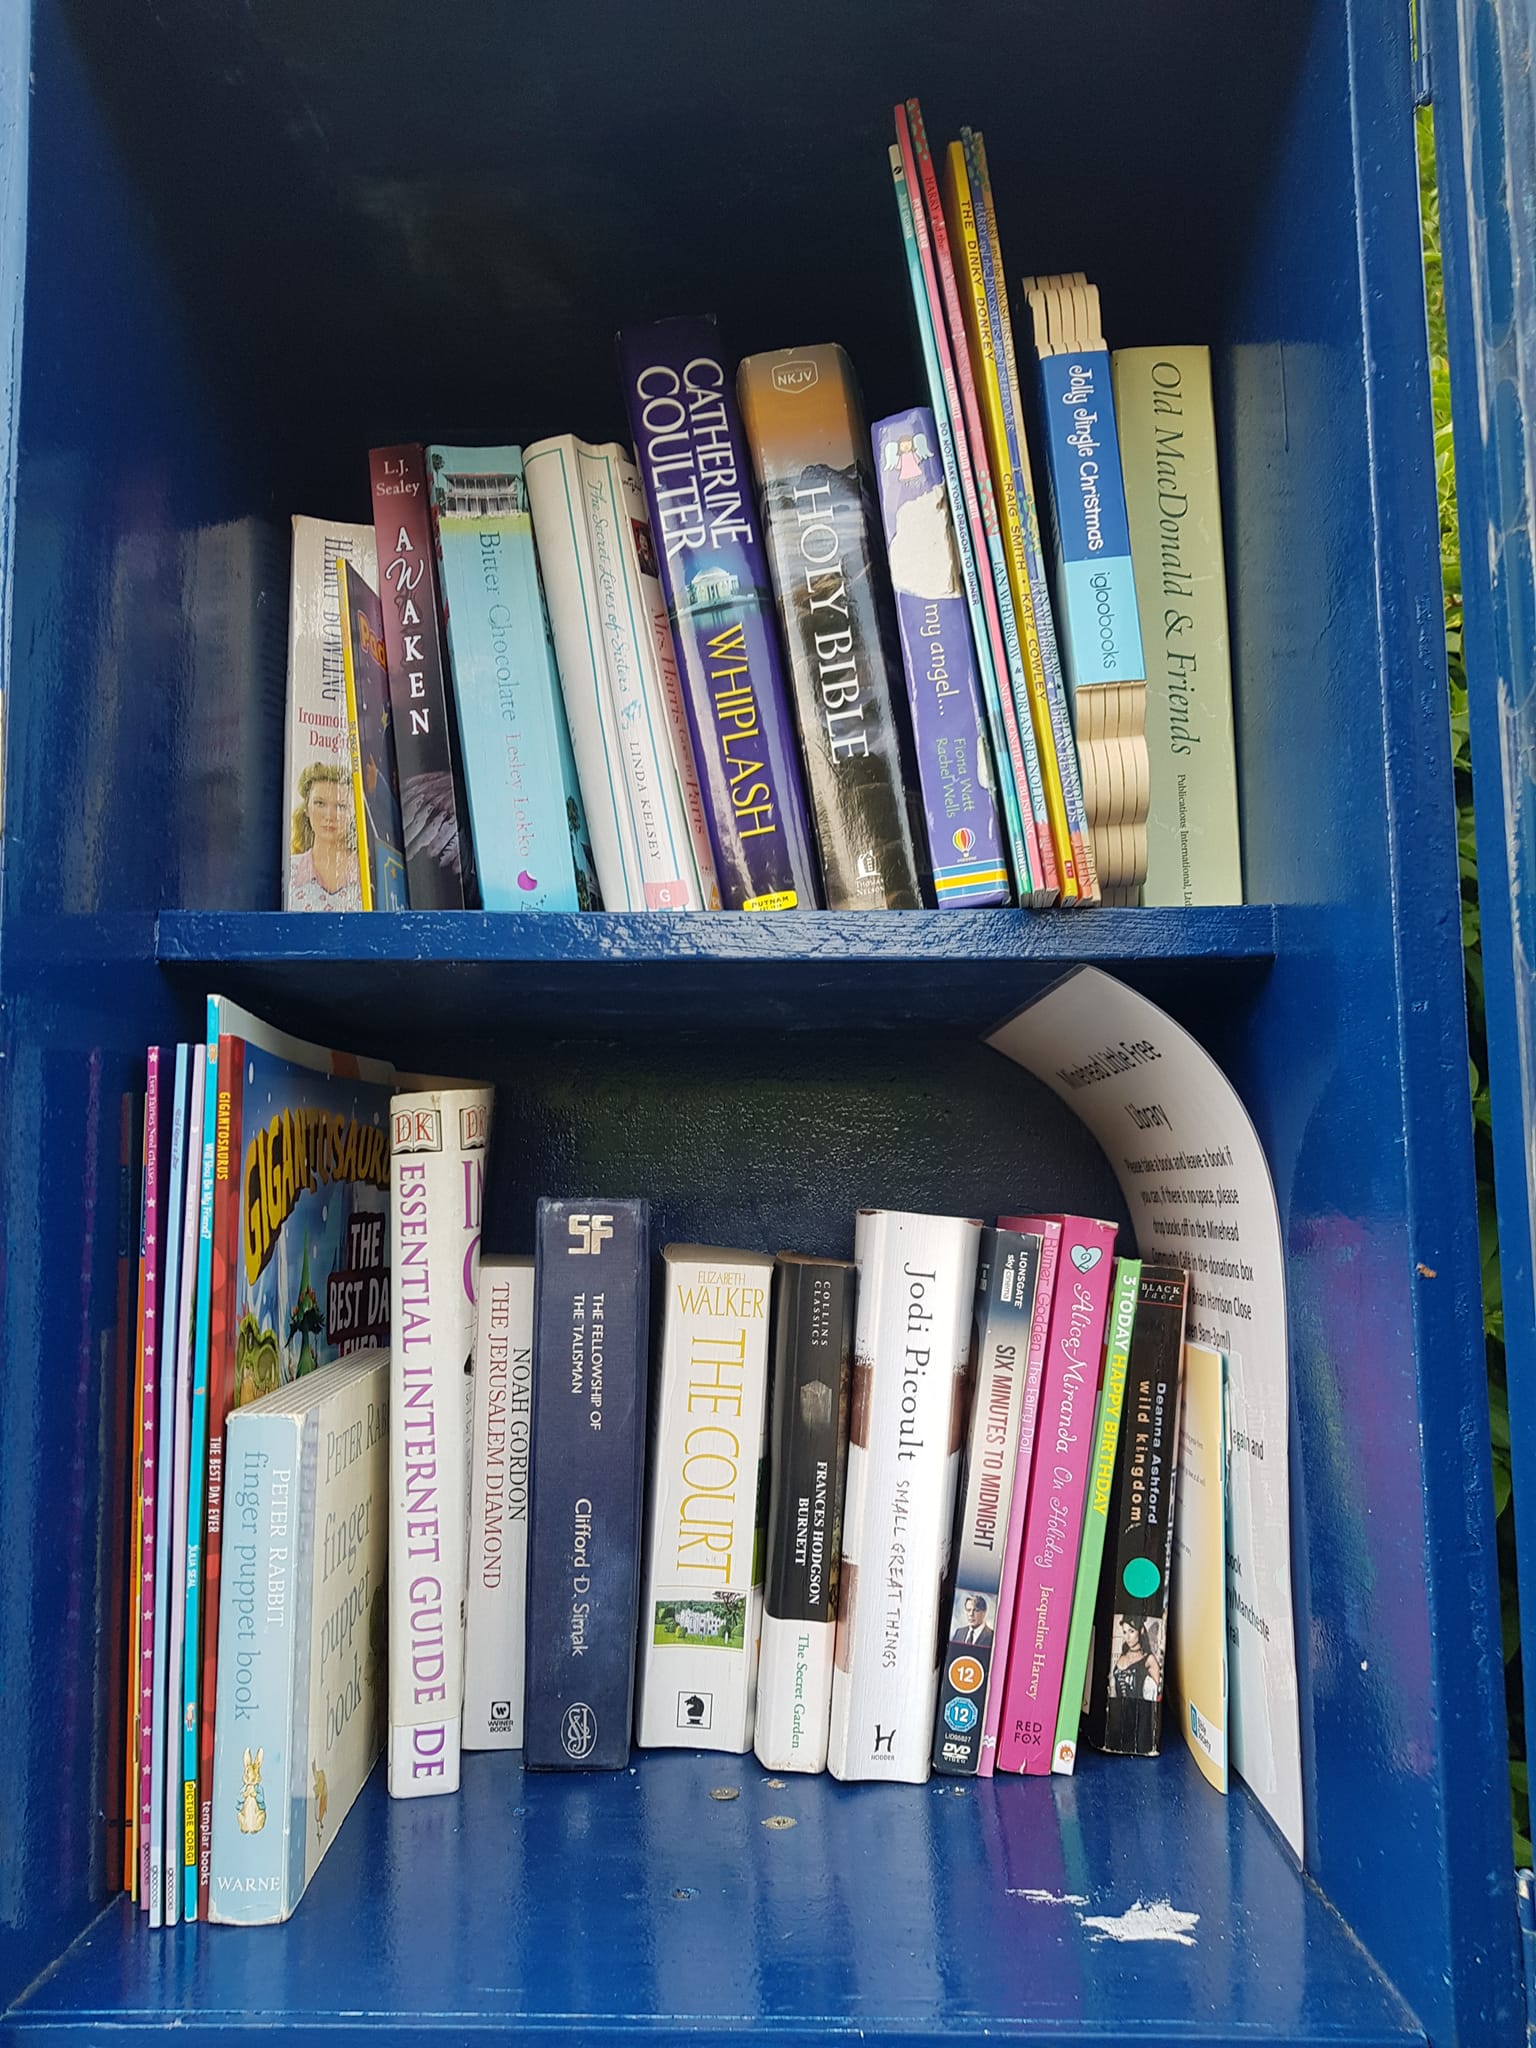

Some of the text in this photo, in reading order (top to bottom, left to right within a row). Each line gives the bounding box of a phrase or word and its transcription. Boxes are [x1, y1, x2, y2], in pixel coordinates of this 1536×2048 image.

[778, 370, 813, 386] NKJV
[376, 481, 420, 497] Sealey
[384, 460, 409, 476] L.J.
[637, 366, 707, 561] COULTER
[682, 357, 753, 549] CATHERINE
[961, 200, 1046, 700] THE DINKY DONKEY CRAIG SMITH KATZ COWLEY
[1063, 364, 1105, 551] Jolly Jingle Christmas
[939, 422, 980, 606] DO NOT TAKE YOUR DRAGON TO DINNER
[1151, 361, 1200, 756] Old MacDonald & Friends
[386, 526, 431, 736] AWAKEN
[479, 530, 521, 722] Bitter Chocolate
[588, 480, 631, 693] The Secret Lives of Sisters
[793, 481, 870, 764] HOLY BIBLE
[920, 603, 941, 636] my
[1089, 571, 1117, 669] igloobooks
[707, 622, 776, 839] WHIPLASH
[953, 737, 976, 812] Fiona Watt
[504, 734, 537, 858] Lesley Lokko
[629, 741, 661, 861] LINDA KELSEY
[936, 737, 960, 819] Rachel Wells
[751, 895, 789, 909] PUTNAM
[1097, 1045, 1136, 1077] Little
[1119, 1039, 1162, 1065] Free
[395, 1112, 432, 1145] DK
[1125, 1103, 1173, 1132] Library
[351, 1221, 381, 1271] THE
[568, 1214, 614, 1255] SF
[698, 1271, 746, 1285] ELIZABETH
[1002, 1254, 1015, 1301] sky cinema
[1078, 1252, 1092, 1270] 2
[207, 1091, 232, 1534] GIGANTOSAURUS THE BEST DAY EVER
[329, 1280, 363, 1335] BEST
[677, 1284, 766, 1319] WALKER
[811, 1280, 822, 1346] CLASSICS
[821, 1281, 831, 1346] COLLINS
[1014, 1251, 1029, 1310] LIONSGATE
[1031, 1236, 1059, 1352] Rumer Godden
[1141, 1283, 1181, 1295] BLACK
[1206, 1290, 1233, 1316] Harrison
[1233, 1296, 1252, 1320] Close
[571, 1292, 585, 1394] THE TALISMAN
[589, 1292, 605, 1431] THE FELLOWSHIP OF
[897, 1262, 937, 1461] Jodi Picoult
[400, 1162, 446, 1705] ESSENTIAL INTERNET GUIDE
[482, 1281, 510, 1589] THE JERUSALEM DIAMOND
[508, 1347, 531, 1522] NOAH GORDON
[1019, 1359, 1043, 1454] The Fairy Doll
[1034, 1282, 1095, 1568] Alice-Miranda On Holiday
[1093, 1274, 1137, 1515] 3 TODAY HAPPY BIRTHDAY
[676, 1328, 746, 1585] THE COURT
[973, 1344, 1016, 1551] SIX MINUTES TO MIDNIGHT
[1130, 1380, 1151, 1523] wild kingdom
[1147, 1382, 1167, 1524] Deanna Ashford
[1233, 1428, 1264, 1461] again and
[266, 1468, 291, 1628] PETER RABBIT
[322, 1493, 373, 1581] finger
[574, 1498, 593, 1568] Clifford
[795, 1497, 810, 1567] BURNETT
[808, 1461, 828, 1606] FRANCES HODGSON
[882, 1480, 910, 1669] SMALL GREAT THINGS
[232, 1452, 269, 1721] finger puppet book
[320, 1569, 371, 1687] puppet
[571, 1602, 590, 1657] Simak
[957, 1666, 975, 1683] 12
[1025, 1583, 1055, 1701] Jacqueline Harvey
[326, 1648, 363, 1752] book
[487, 1719, 515, 1728] WARNER
[791, 1632, 810, 1749] The Secret Garden
[954, 1706, 969, 1723] 12
[1015, 1719, 1042, 1732] RED
[412, 1725, 445, 1779] DE
[943, 1742, 971, 1756] DVD
[1014, 1732, 1042, 1746] FOX
[186, 1783, 194, 1863] PICTURE CORGI
[201, 1800, 211, 1886] templar books
[216, 1877, 280, 1892] WARNE
